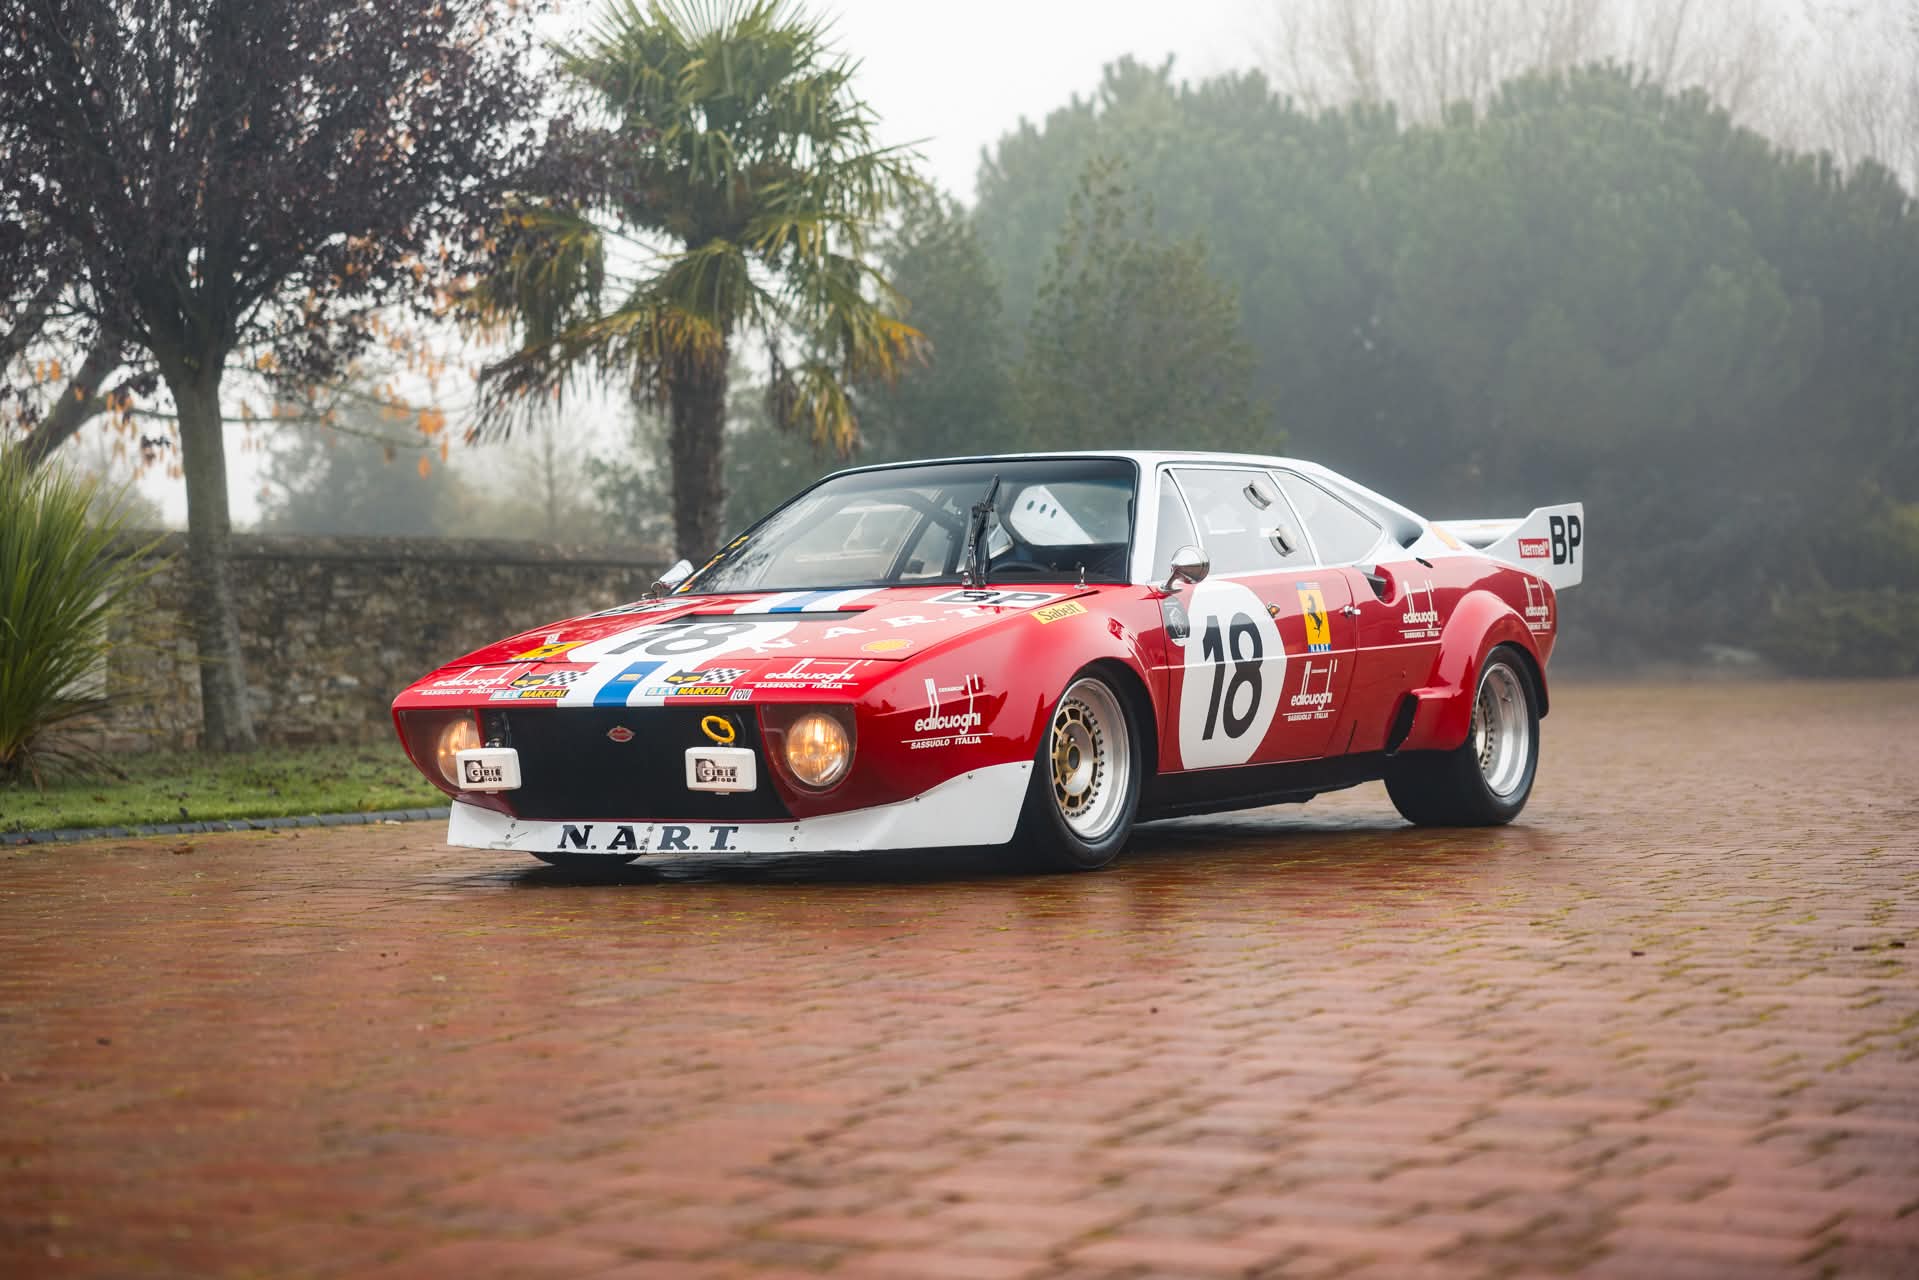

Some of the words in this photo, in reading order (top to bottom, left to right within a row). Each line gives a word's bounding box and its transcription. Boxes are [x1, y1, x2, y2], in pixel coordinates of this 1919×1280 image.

[1549, 515, 1581, 565] BP
[935, 591, 1051, 604] BP
[1037, 603, 1081, 621] Sabelt
[604, 623, 757, 656] 18
[1202, 612, 1263, 741] 18
[677, 687, 728, 696] MARCHAL
[733, 689, 752, 700] TOW
[911, 738, 950, 750] SASSUOLO
[955, 736, 981, 746] ITALIA
